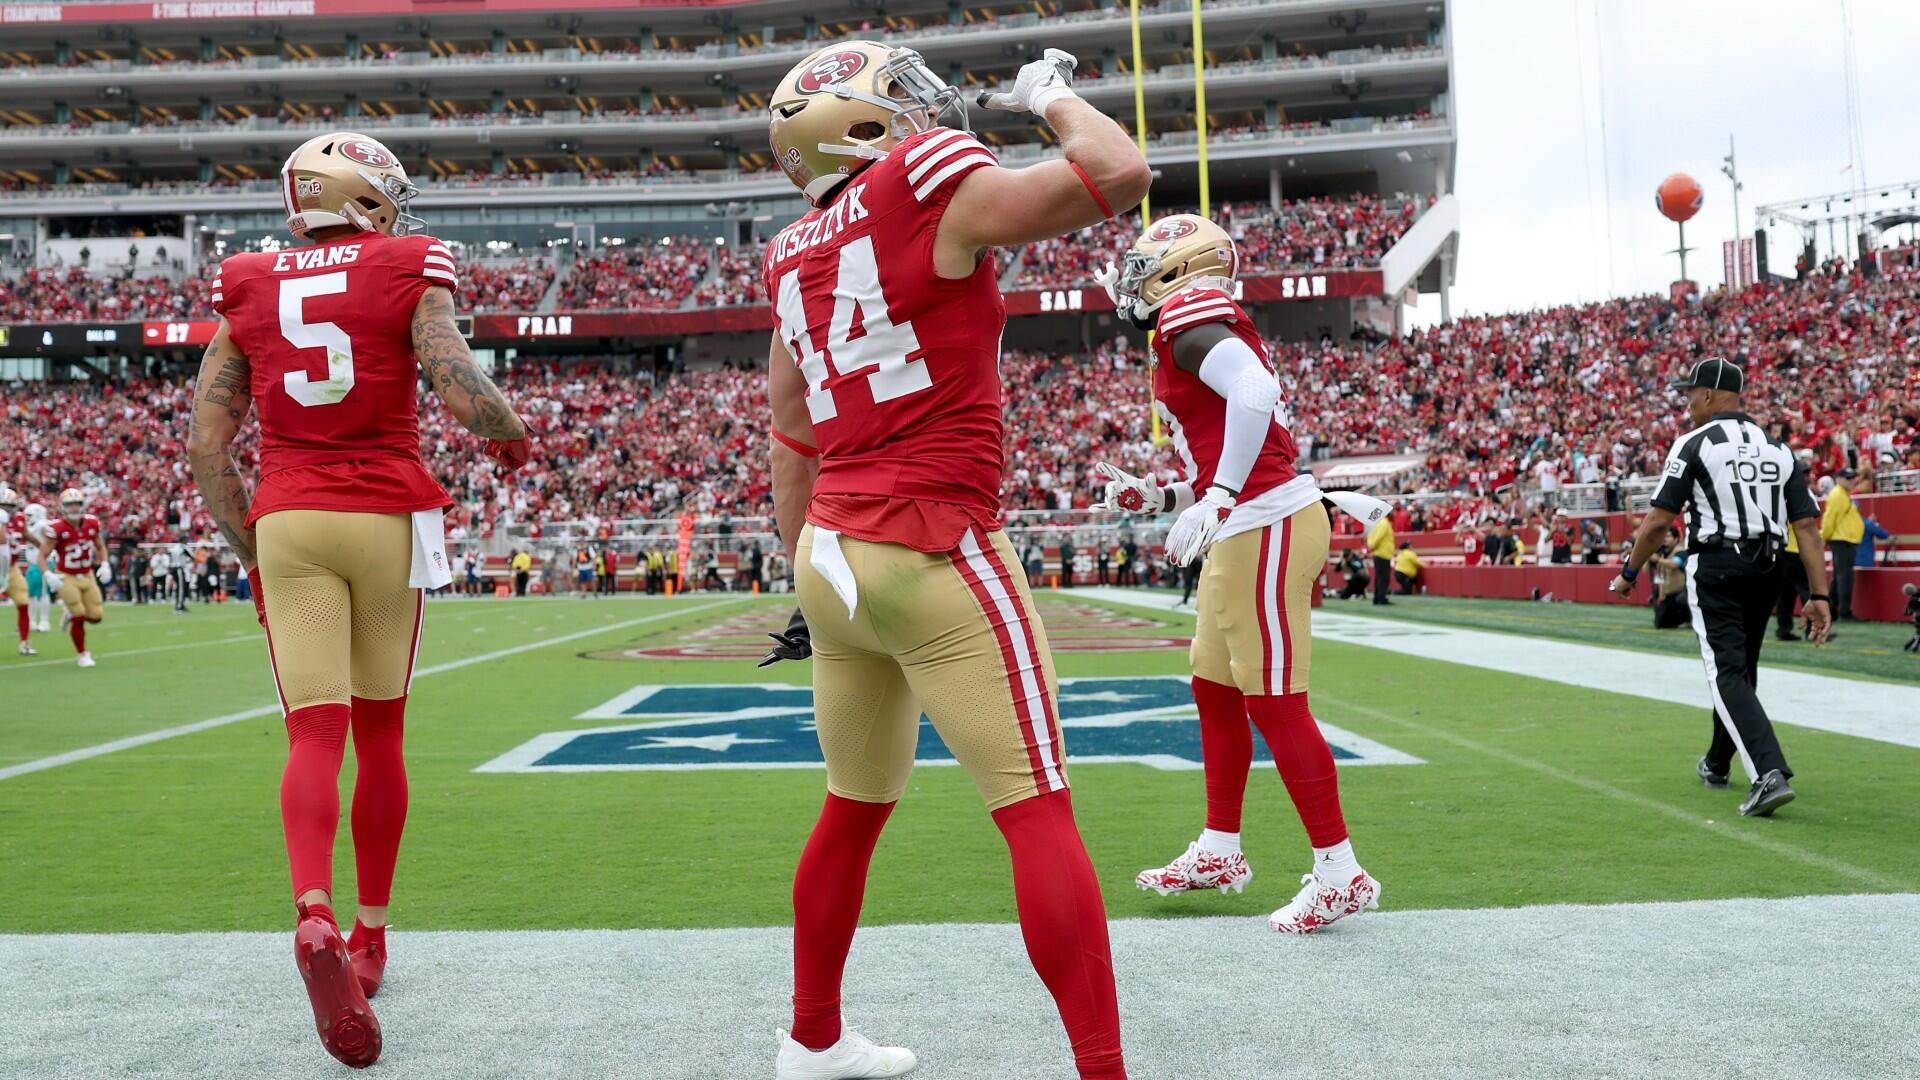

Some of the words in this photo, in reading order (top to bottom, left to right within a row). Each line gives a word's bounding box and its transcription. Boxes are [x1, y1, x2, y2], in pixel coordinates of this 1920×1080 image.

[309, 182, 321, 194] 12
[273, 244, 363, 272] EVANS
[1282, 276, 1327, 298] SAN
[1040, 290, 1083, 311] SAN
[518, 316, 572, 335] FRAN
[775, 235, 933, 425] 44
[278, 271, 355, 407] 5
[1725, 460, 1780, 483] 109
